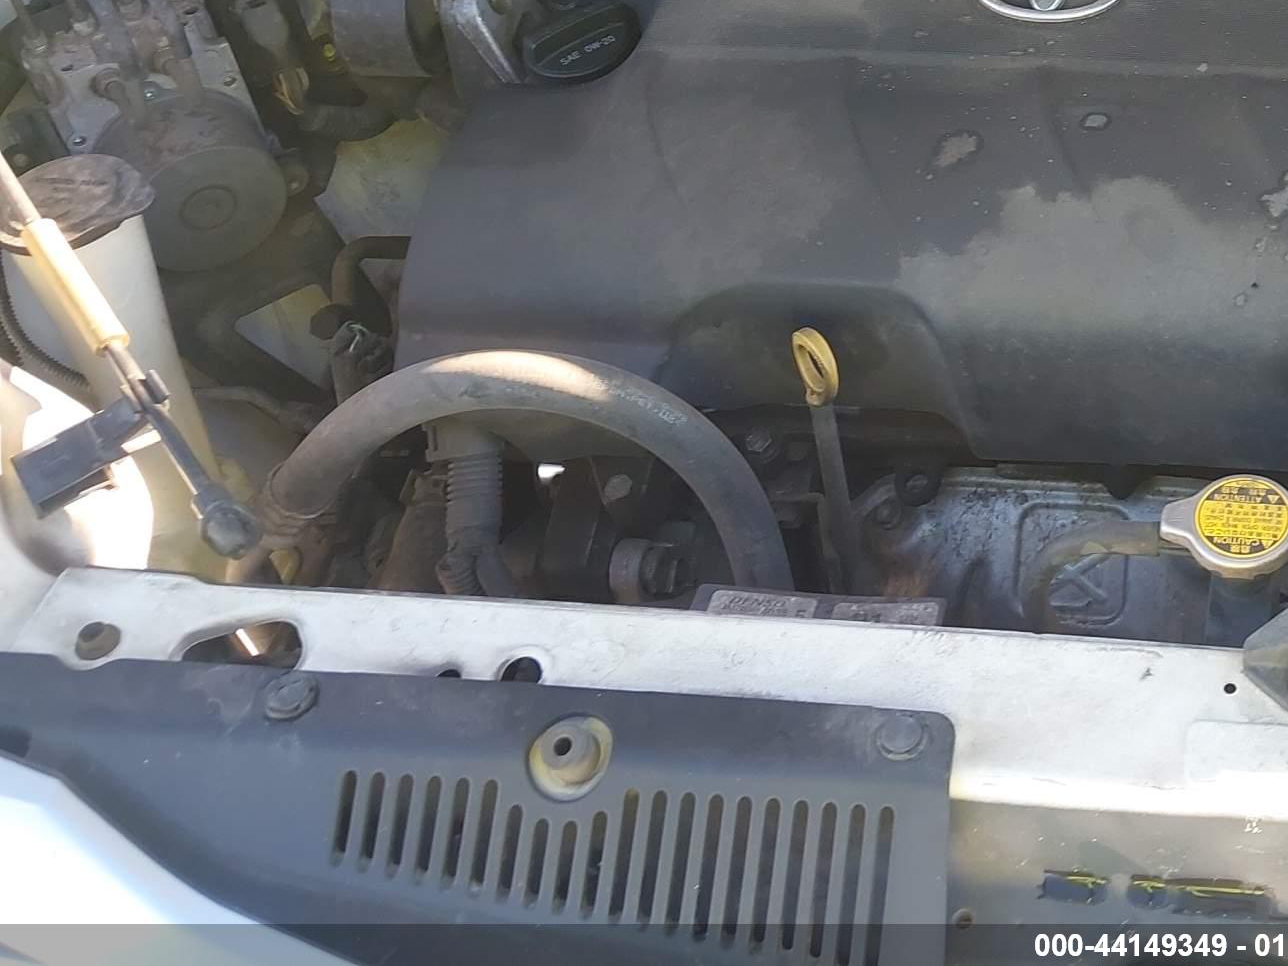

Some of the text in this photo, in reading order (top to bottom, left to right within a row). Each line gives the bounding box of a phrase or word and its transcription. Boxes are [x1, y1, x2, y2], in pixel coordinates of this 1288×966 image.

[560, 35, 616, 66] SAE 0W-20
[1213, 536, 1261, 547] CAUTION
